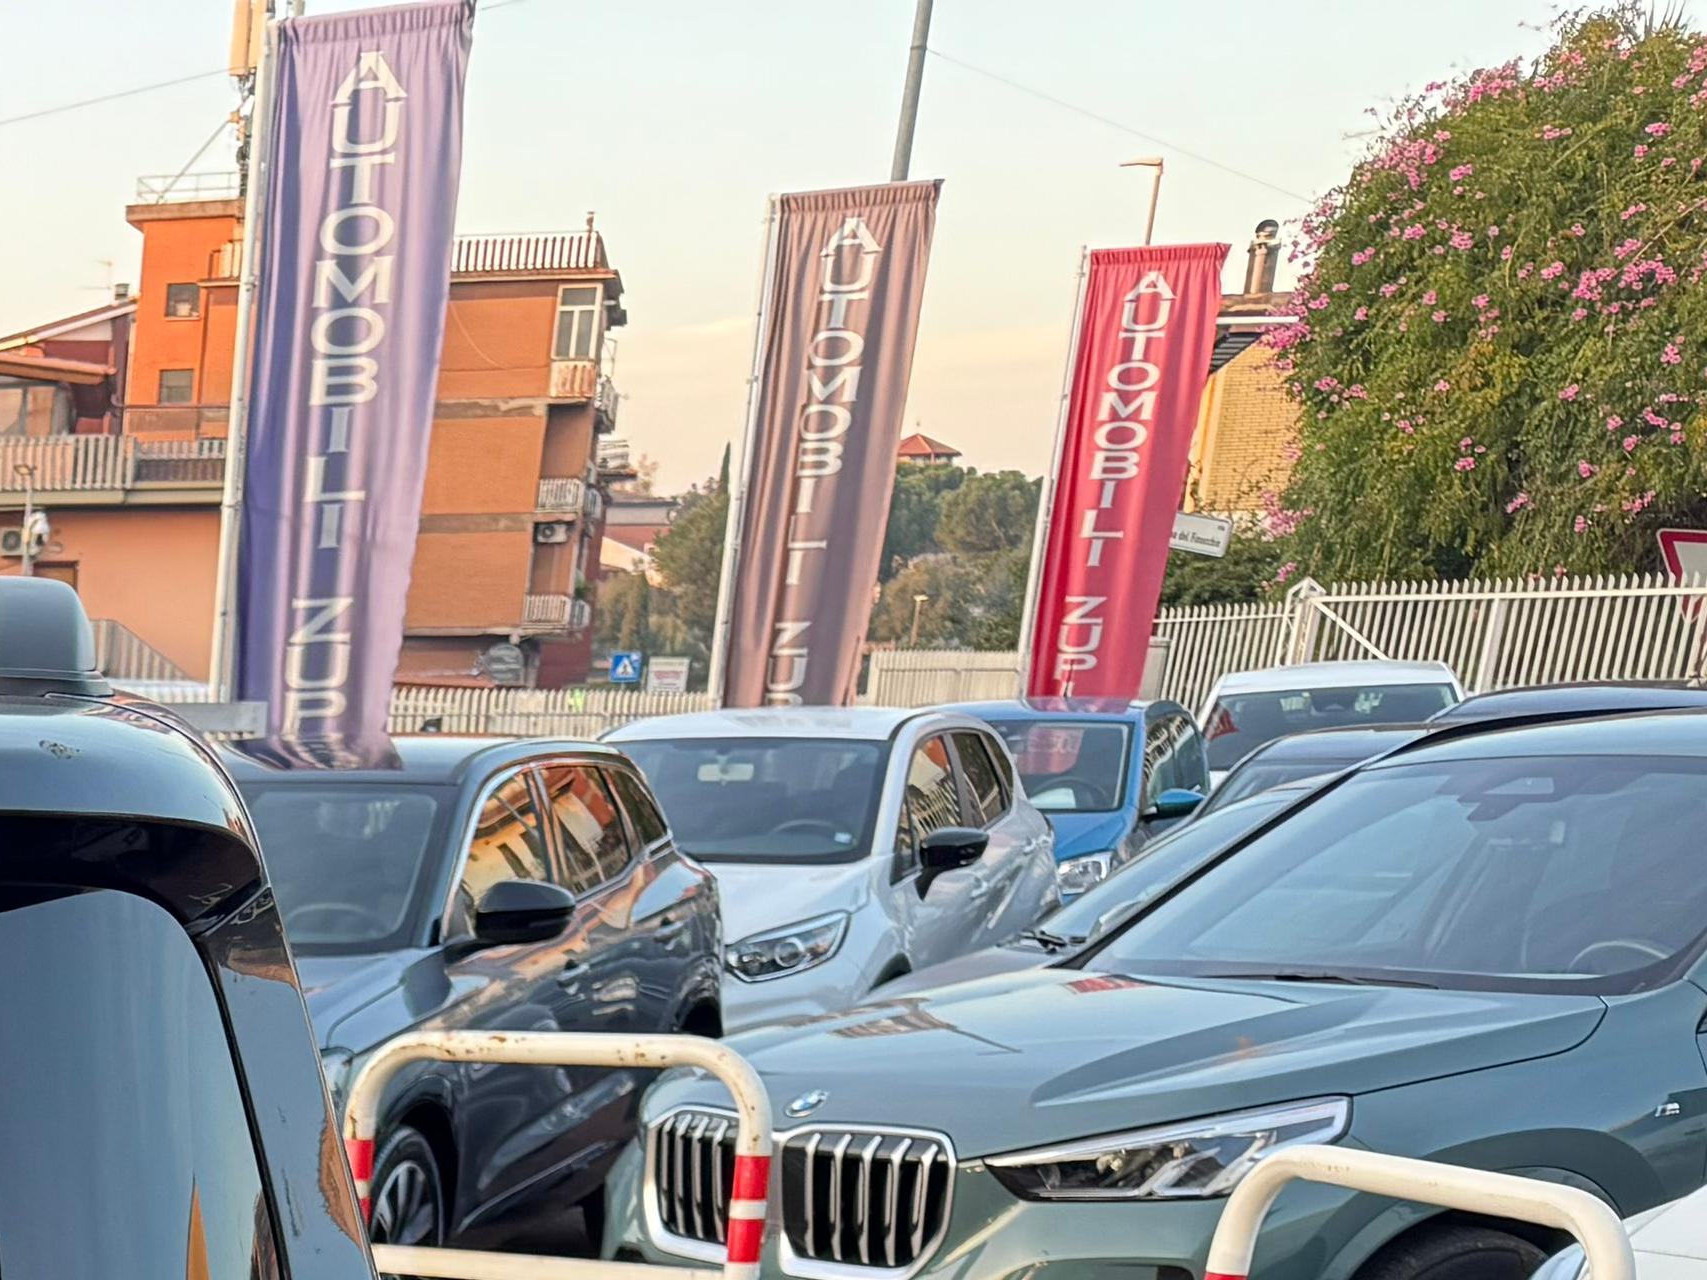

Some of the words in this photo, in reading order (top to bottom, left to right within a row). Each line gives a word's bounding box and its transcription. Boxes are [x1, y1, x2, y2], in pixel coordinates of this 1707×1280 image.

[302, 50, 407, 550] AUTOMOBILI
[785, 217, 881, 585] AUTOMOBILI
[1080, 271, 1176, 566] AUTOMOBILI
